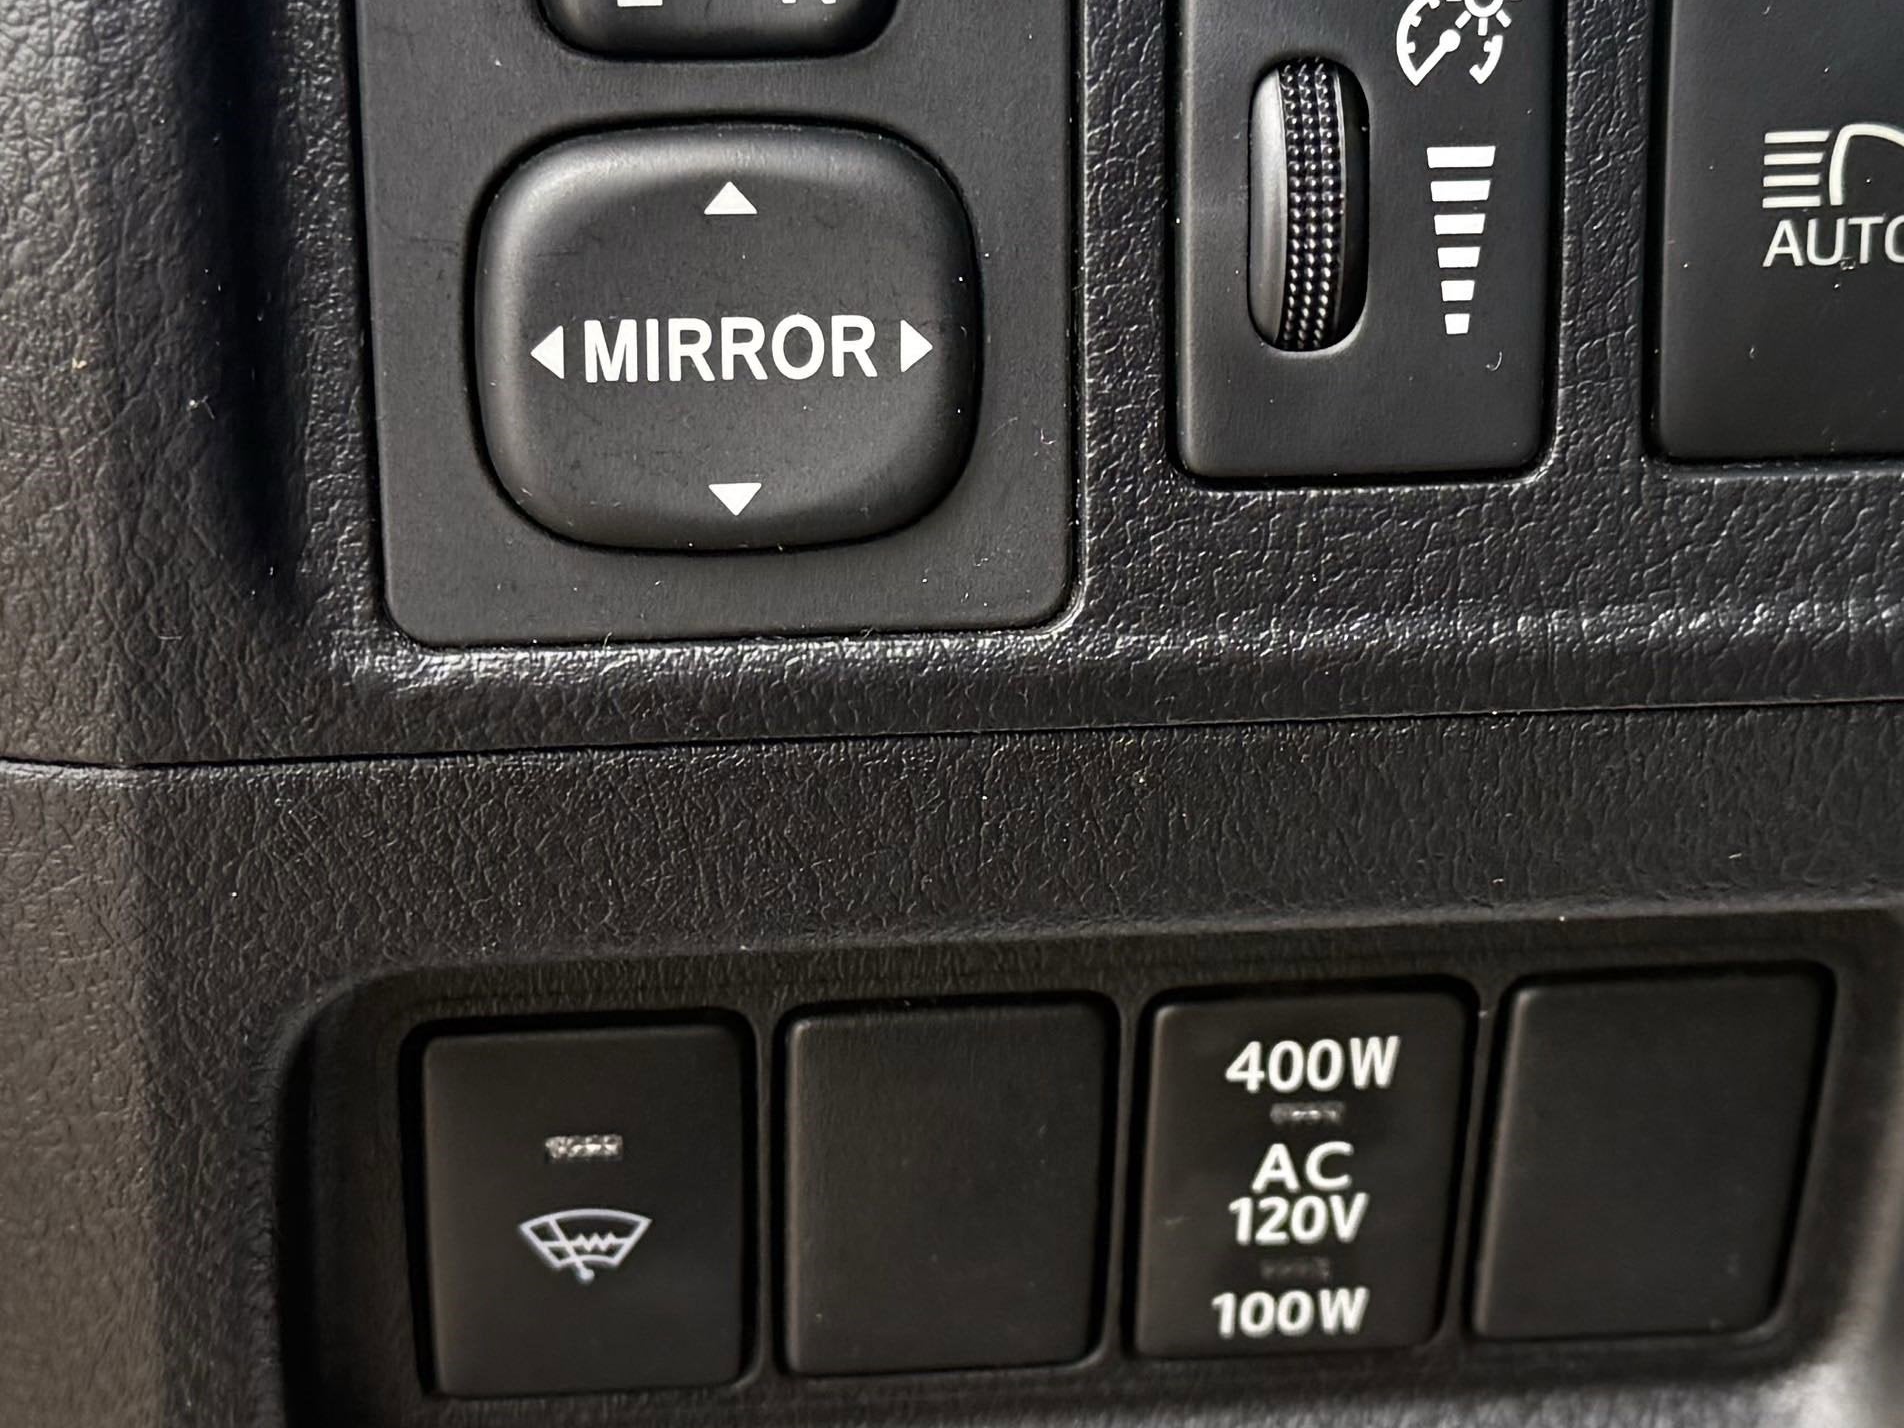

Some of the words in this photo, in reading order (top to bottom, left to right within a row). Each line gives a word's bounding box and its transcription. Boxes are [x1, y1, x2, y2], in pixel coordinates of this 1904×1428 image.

[583, 311, 880, 384] MIRROR
[1225, 1035, 1401, 1094] 400W
[1251, 1140, 1355, 1194] AC
[1228, 1192, 1370, 1246] 120V
[1211, 1286, 1370, 1339] 100W
